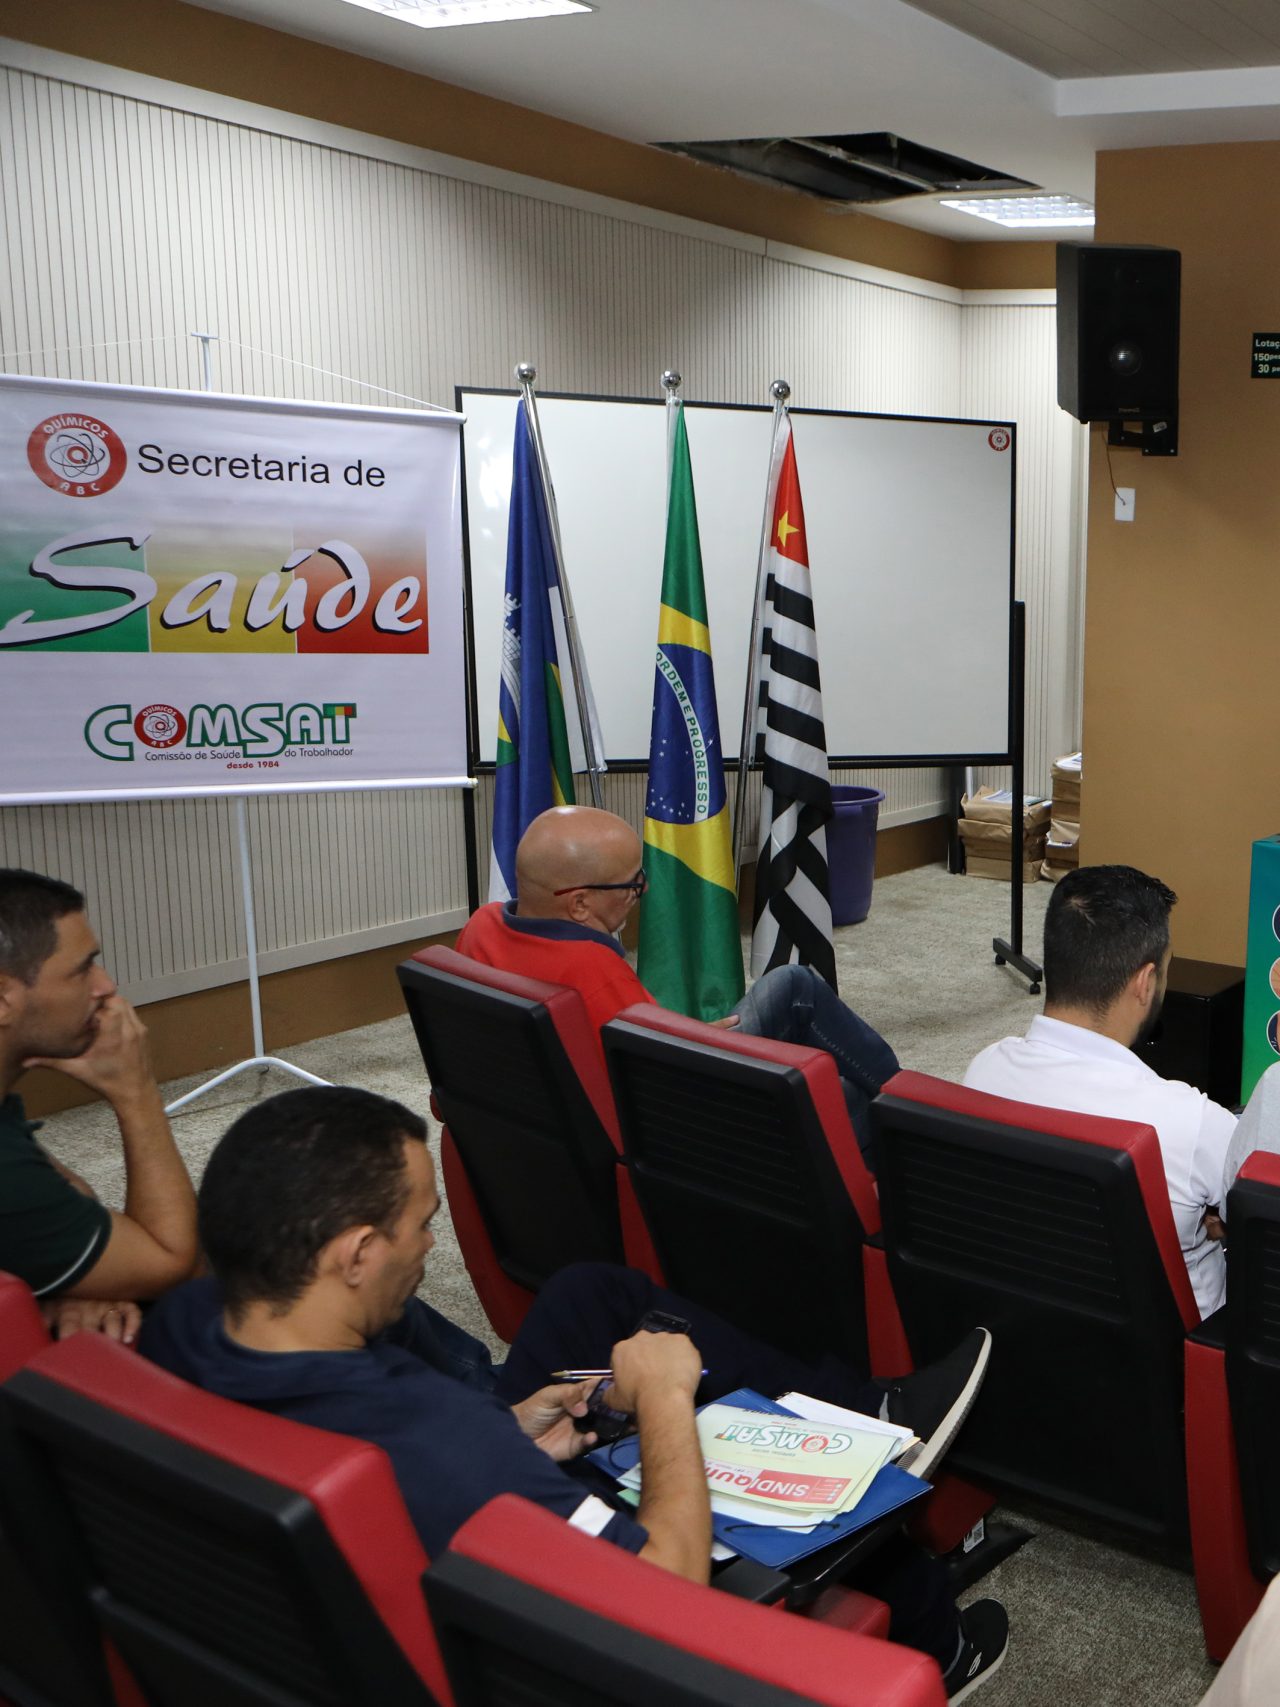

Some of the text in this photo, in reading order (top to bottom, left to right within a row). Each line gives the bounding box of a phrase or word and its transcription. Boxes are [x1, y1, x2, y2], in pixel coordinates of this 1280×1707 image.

[1253, 353, 1269, 361] 150
[1258, 364, 1269, 373] 30
[44, 415, 109, 439] QUÍMICOS
[138, 444, 386, 487] Secretaria de
[0, 526, 424, 649] Saúde
[656, 651, 708, 814] ORDEM E PROGRESSO
[145, 747, 354, 761] Comissão de Saúde do Trabalhador
[226, 760, 279, 769] desde 1984
